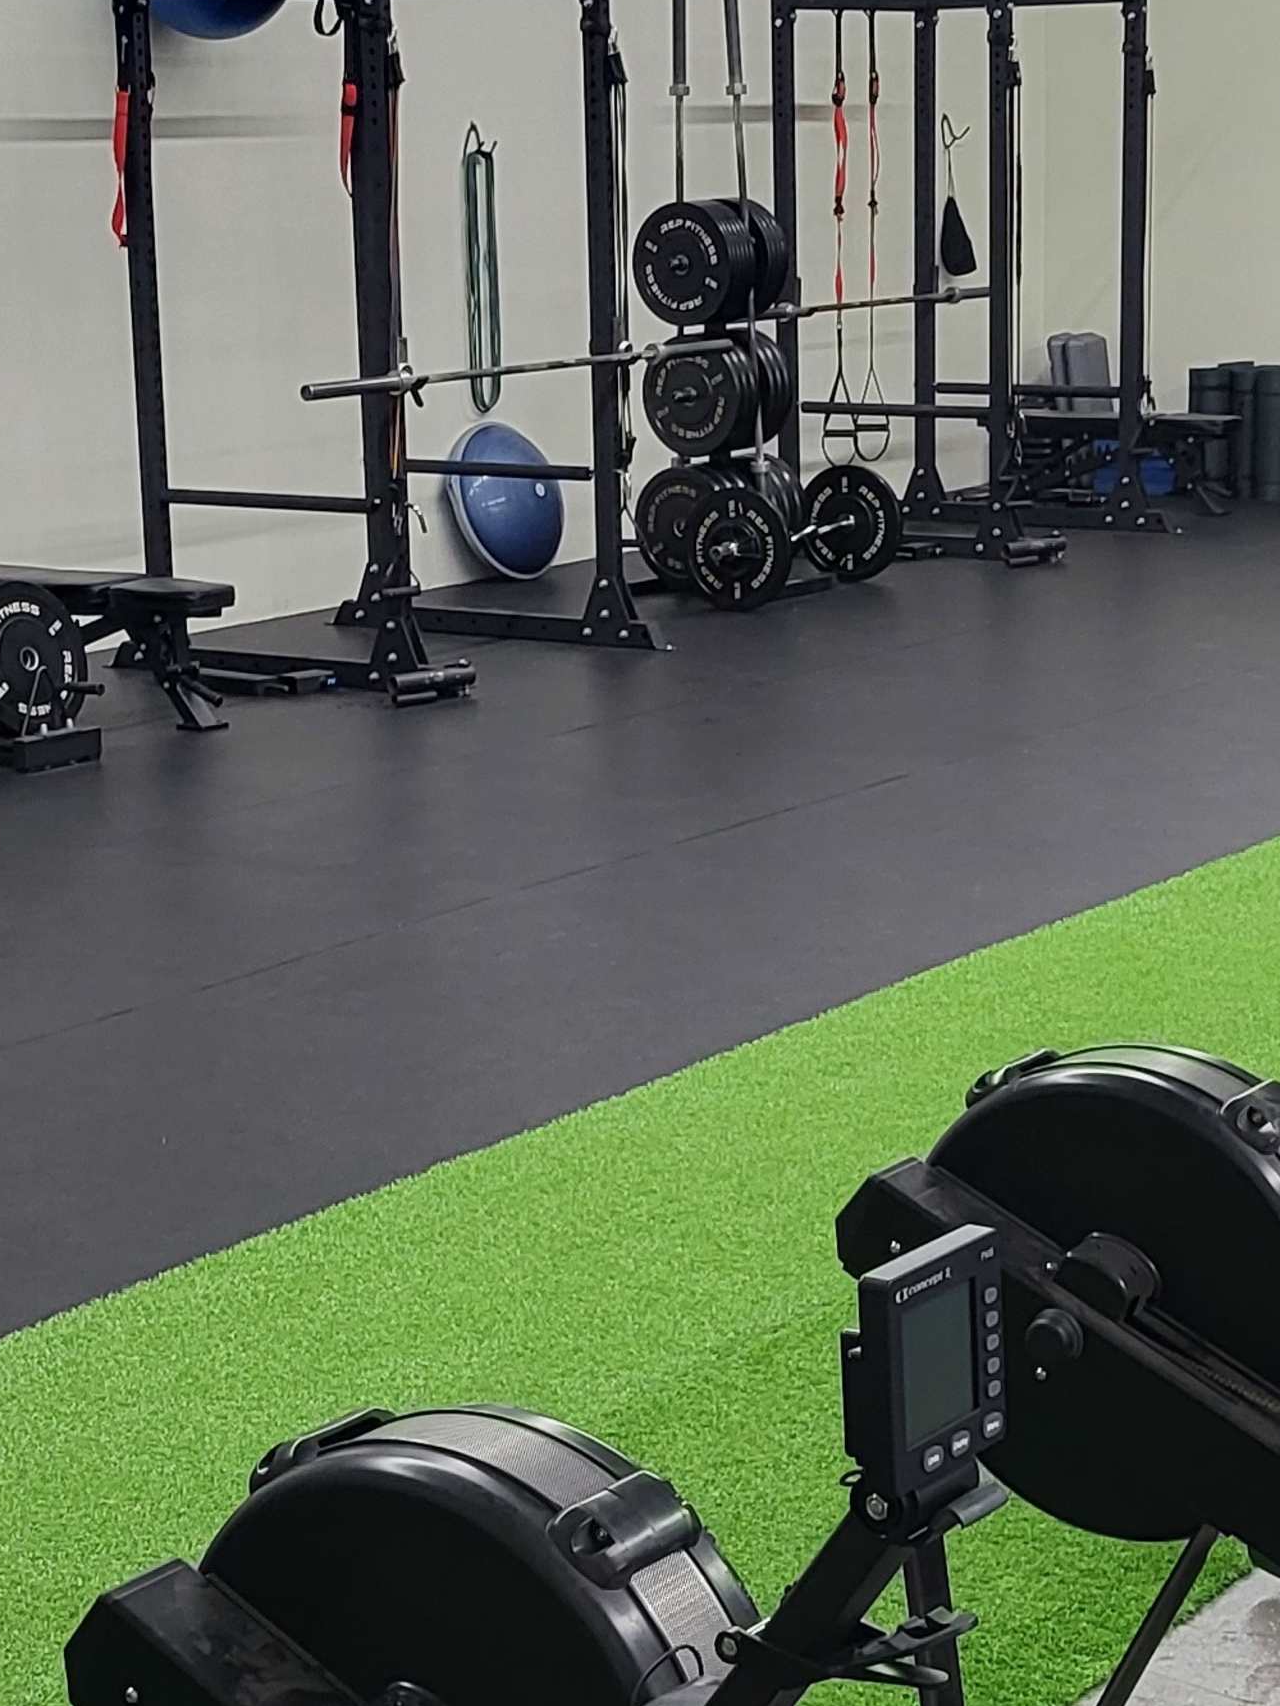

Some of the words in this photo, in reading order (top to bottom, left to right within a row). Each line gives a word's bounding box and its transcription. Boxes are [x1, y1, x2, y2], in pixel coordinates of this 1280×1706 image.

[684, 219, 719, 266] FITNESS
[858, 485, 881, 508] REP
[696, 510, 720, 565] FITNESS
[746, 509, 770, 534] REP
[862, 510, 885, 561] FITNESS
[751, 535, 775, 590] FITNESS
